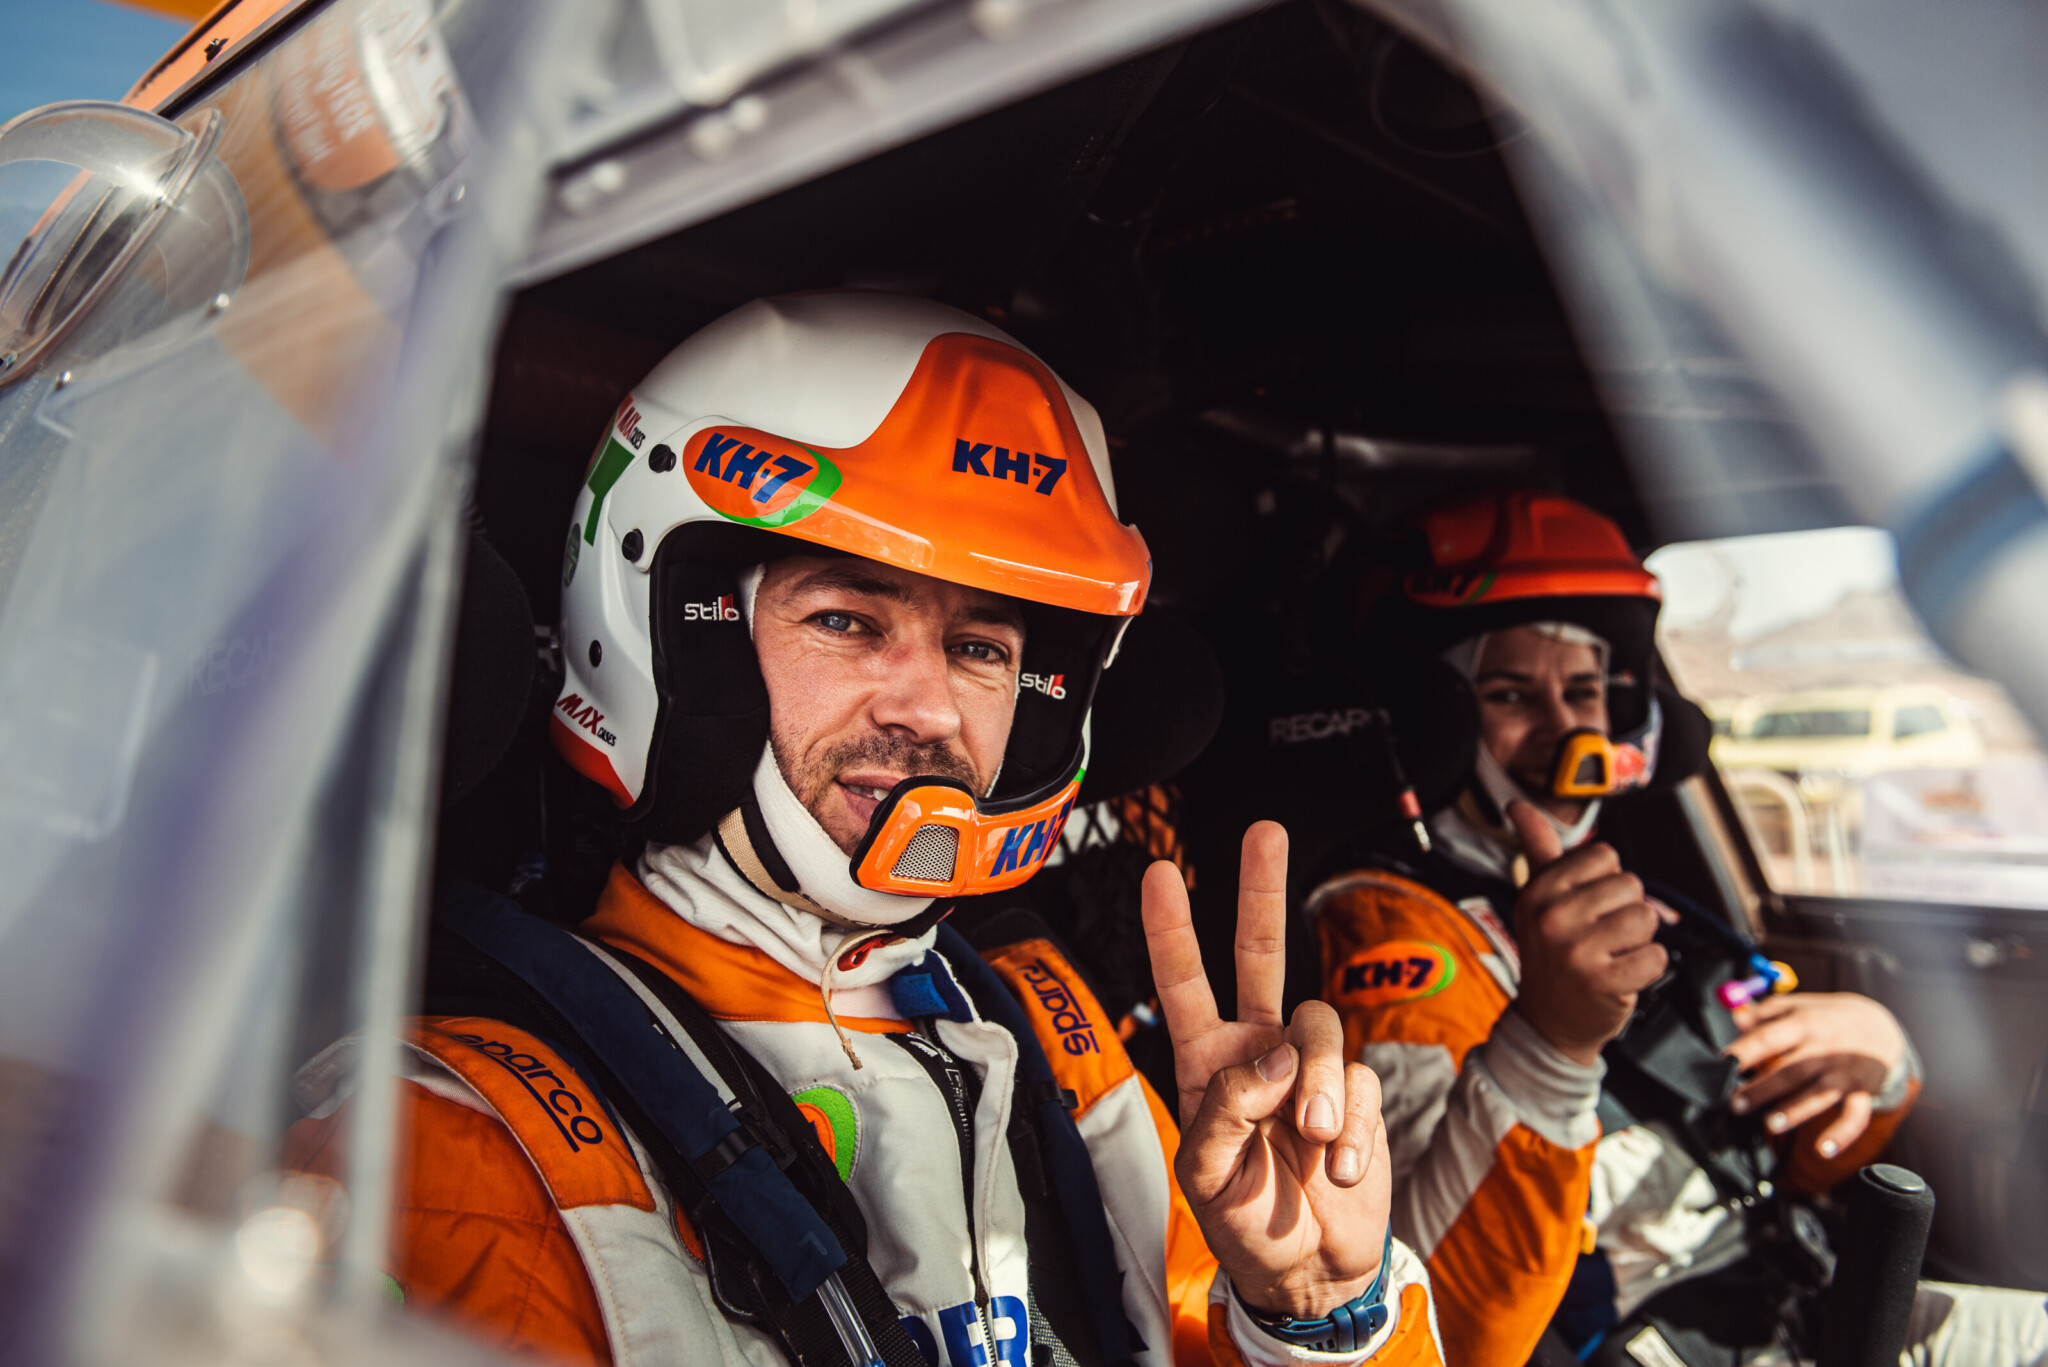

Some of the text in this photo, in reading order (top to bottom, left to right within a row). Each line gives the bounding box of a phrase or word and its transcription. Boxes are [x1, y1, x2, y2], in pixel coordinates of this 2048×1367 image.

[693, 432, 814, 504] KH-7
[952, 438, 1068, 496] KH-7
[556, 693, 605, 735] MAX
